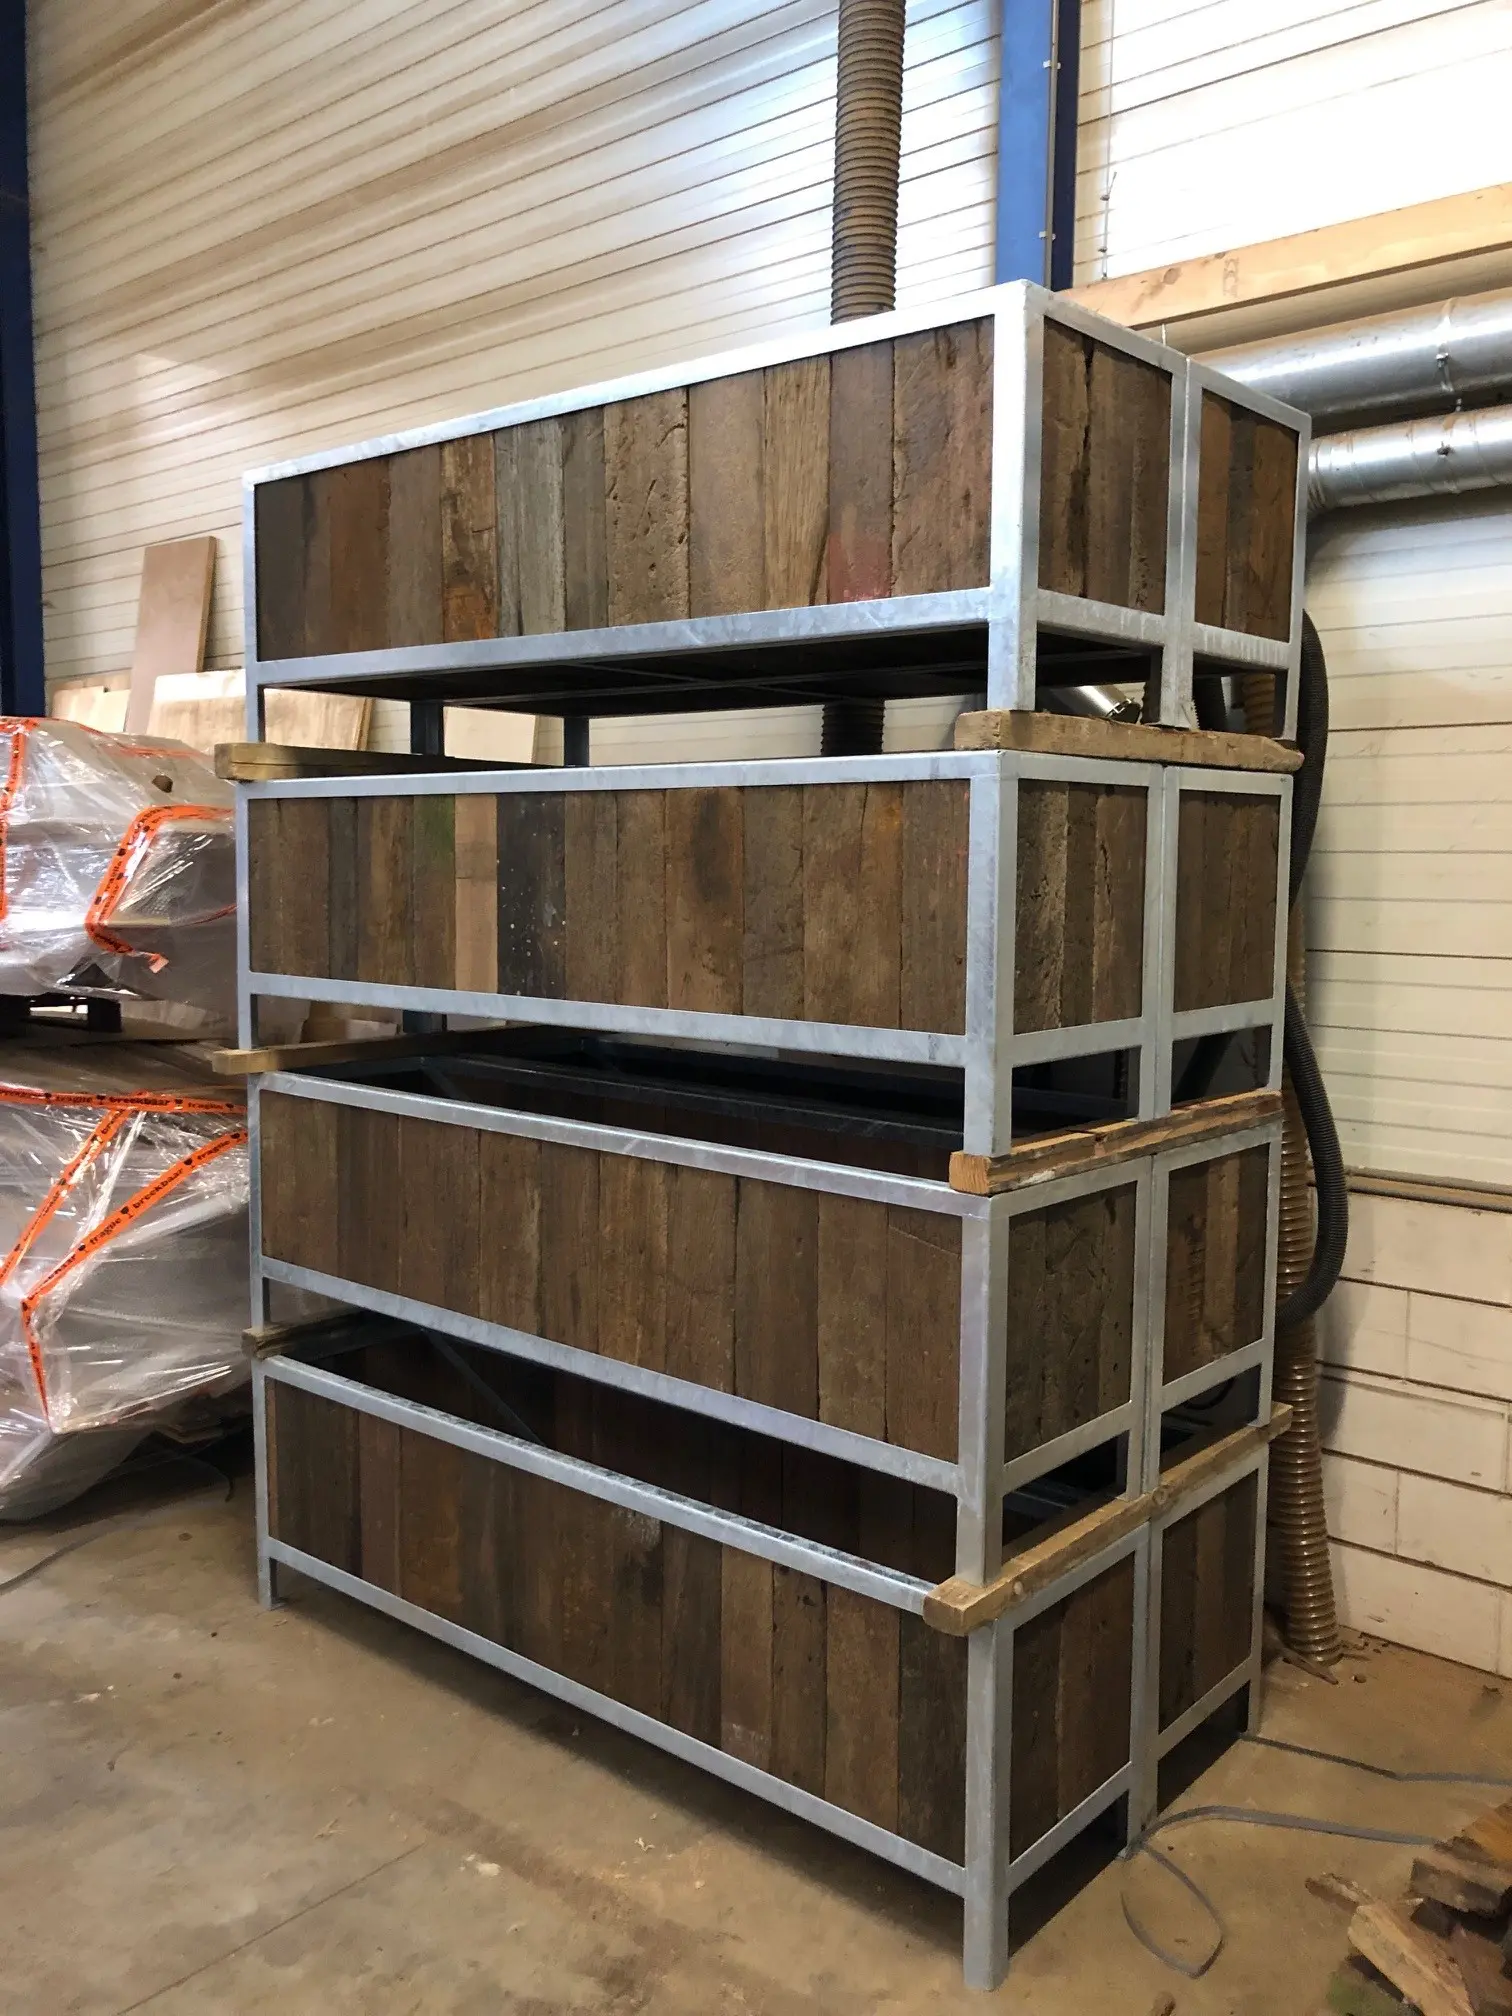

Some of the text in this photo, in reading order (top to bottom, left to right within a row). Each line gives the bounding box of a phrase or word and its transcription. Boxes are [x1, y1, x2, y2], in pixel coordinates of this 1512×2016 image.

[109, 1096, 170, 1105] breekbaar
[90, 1140, 231, 1245] fragile breekbaar fragile
